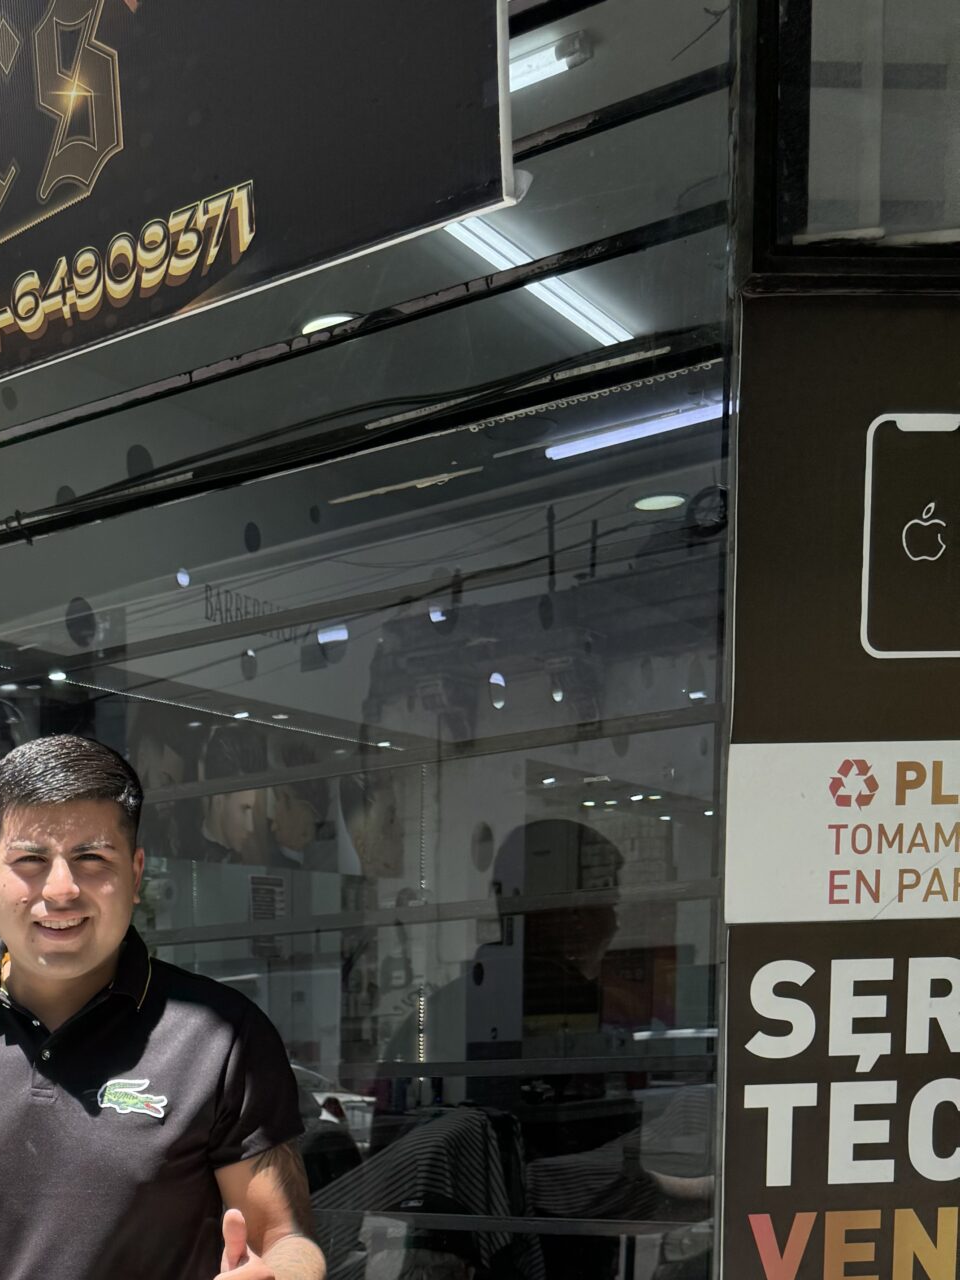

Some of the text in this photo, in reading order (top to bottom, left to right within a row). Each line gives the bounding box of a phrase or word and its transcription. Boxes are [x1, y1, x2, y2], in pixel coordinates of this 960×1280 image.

[895, 760, 959, 806] PL
[827, 822, 960, 855] TOMAM
[828, 869, 881, 904] EN
[744, 957, 960, 1059] SER
